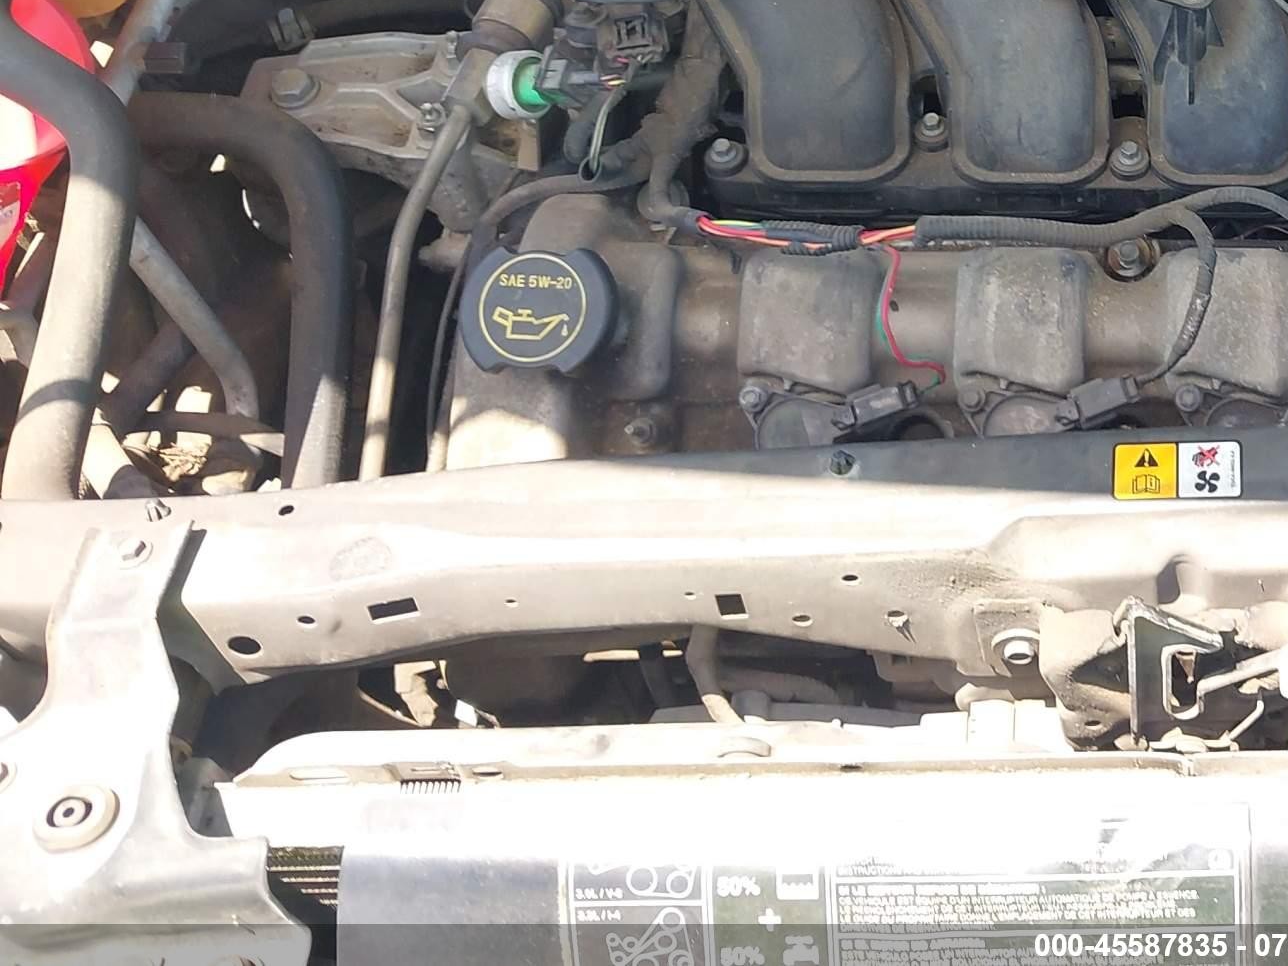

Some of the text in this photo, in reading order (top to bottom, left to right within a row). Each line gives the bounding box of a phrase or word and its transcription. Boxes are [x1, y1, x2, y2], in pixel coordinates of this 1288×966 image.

[500, 273, 573, 290] SAE 5W-20
[716, 875, 761, 898] 50%
[720, 946, 766, 966] 50%
